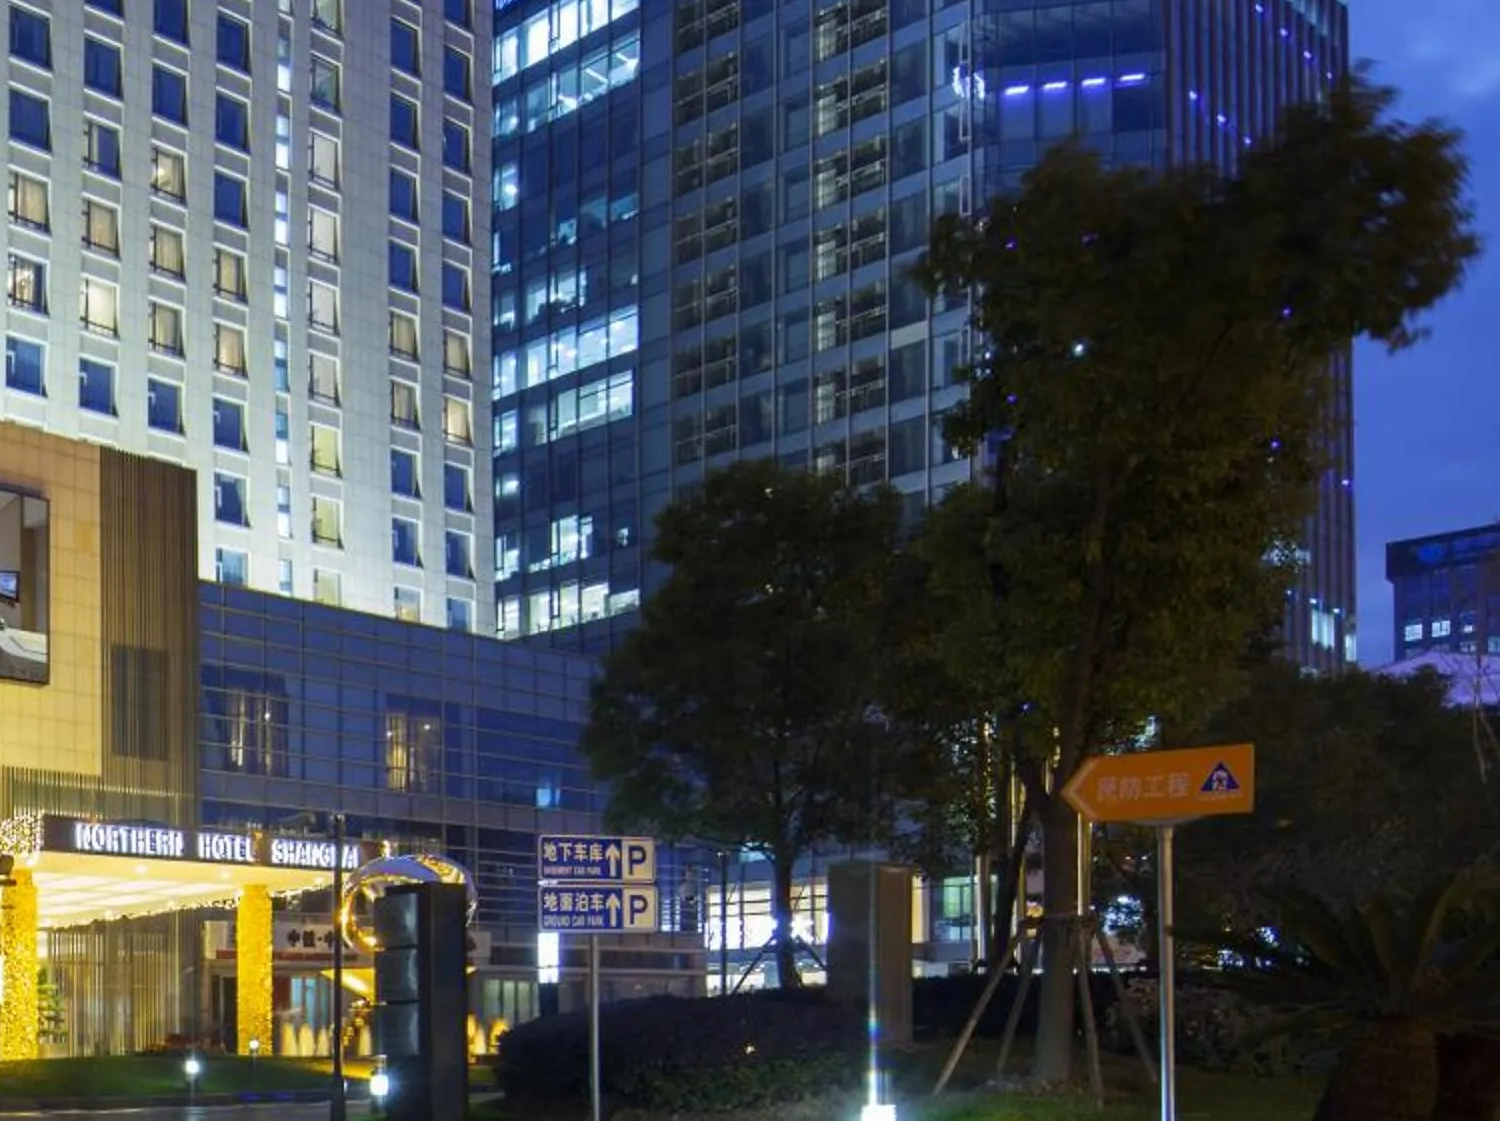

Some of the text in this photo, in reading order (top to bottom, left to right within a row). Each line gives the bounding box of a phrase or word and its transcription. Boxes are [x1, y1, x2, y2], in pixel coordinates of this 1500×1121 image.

[75, 821, 184, 857] NORTHERN
[198, 833, 257, 862] HOTEL
[544, 842, 603, 862] 地下车库
[628, 845, 647, 876] P
[544, 892, 605, 912] 地面泊车
[629, 894, 649, 926] P
